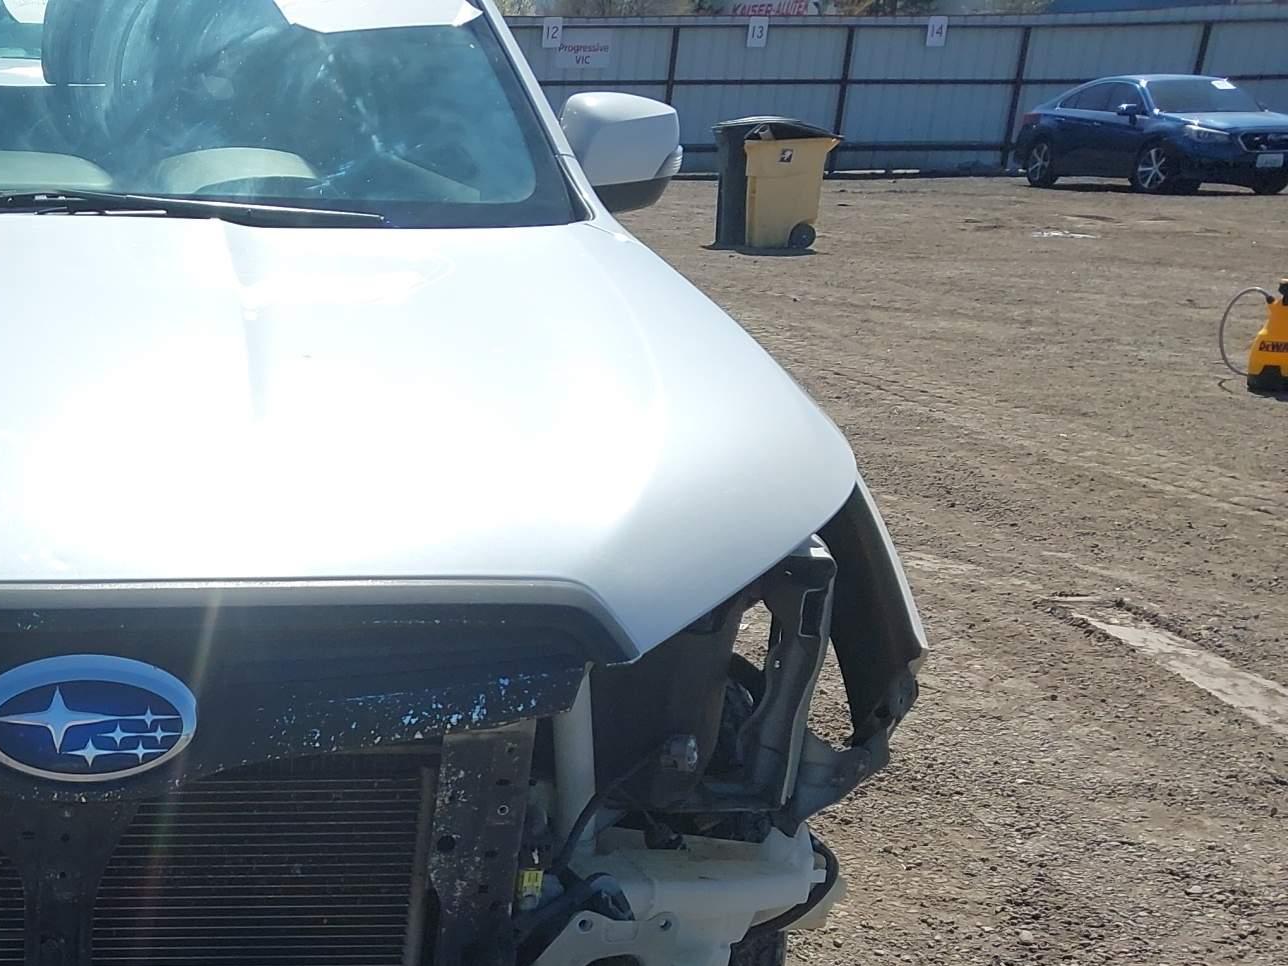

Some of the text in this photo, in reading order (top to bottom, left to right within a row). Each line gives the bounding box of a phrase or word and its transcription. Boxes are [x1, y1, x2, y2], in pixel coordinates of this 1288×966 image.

[546, 25, 560, 40] 12
[752, 25, 764, 39] 13
[930, 23, 944, 38] 14
[558, 43, 609, 54] Progressive
[575, 55, 591, 65] VIC
